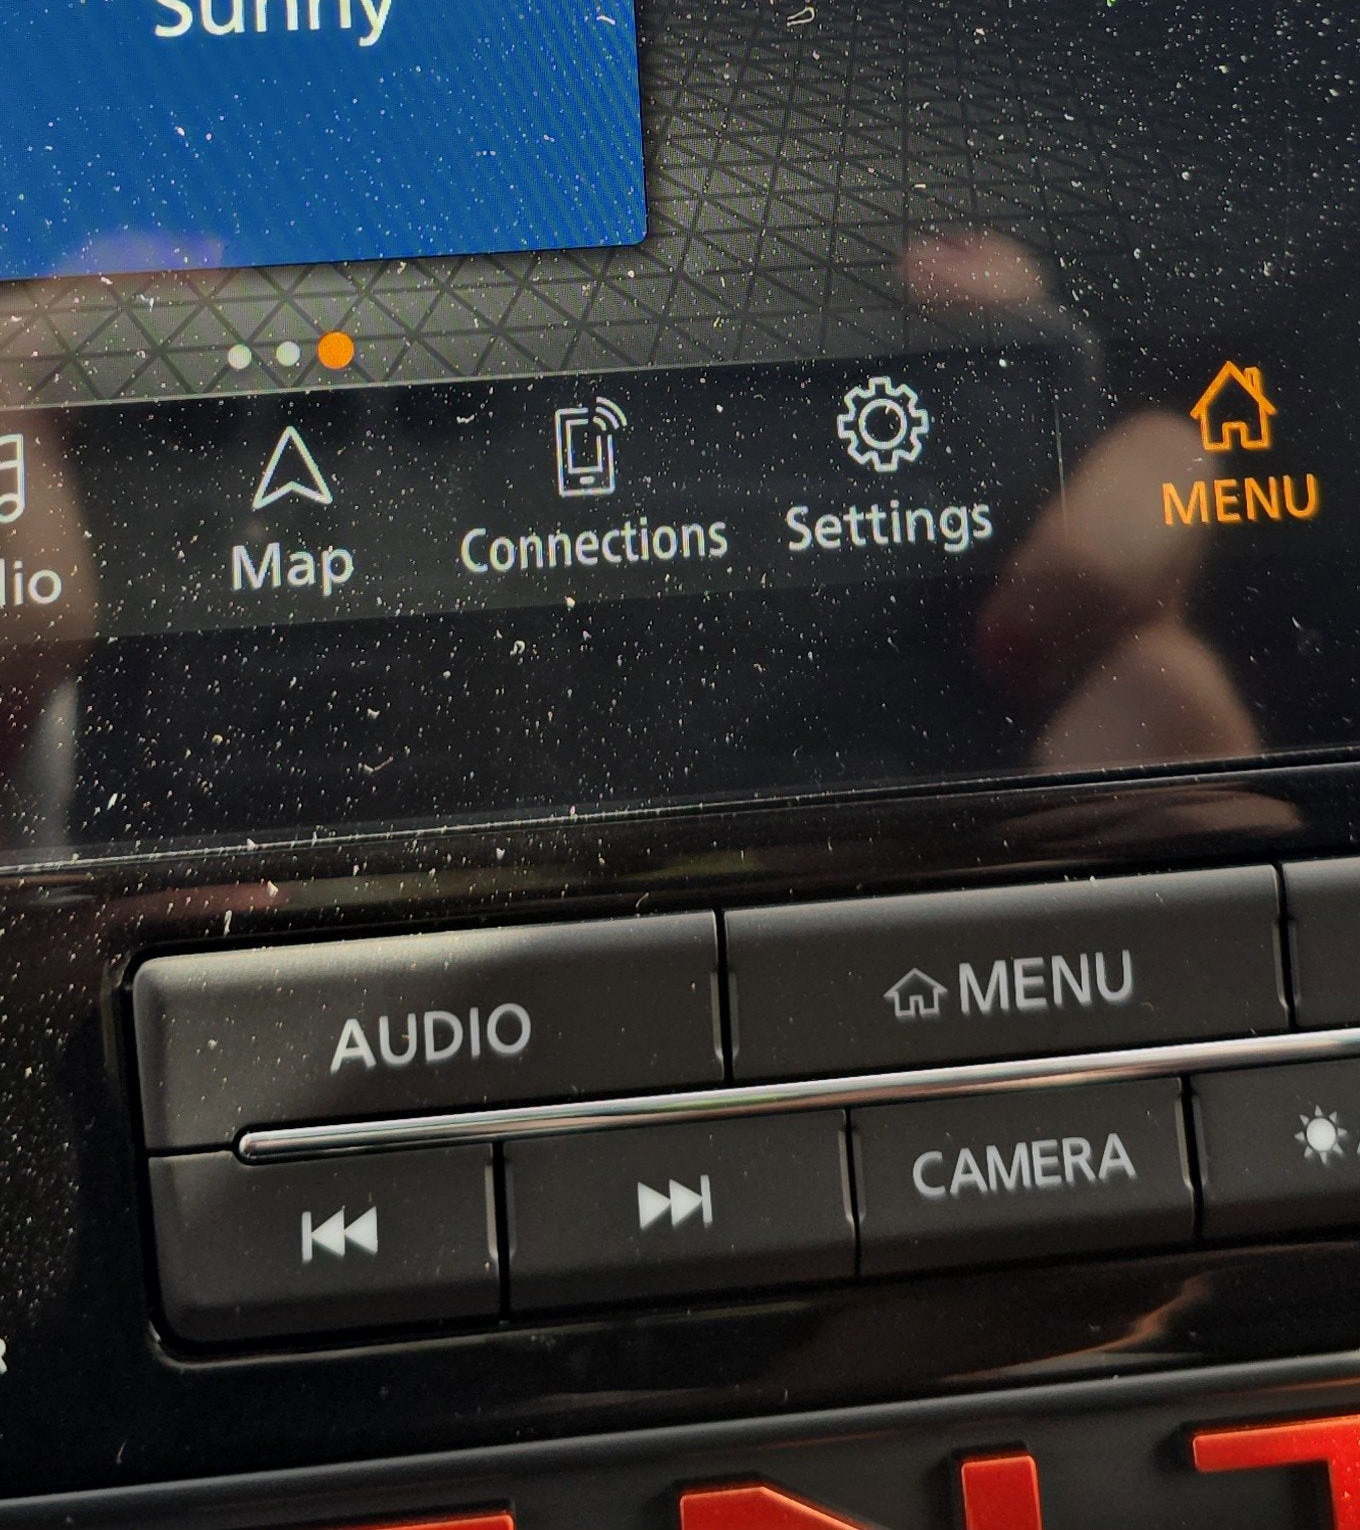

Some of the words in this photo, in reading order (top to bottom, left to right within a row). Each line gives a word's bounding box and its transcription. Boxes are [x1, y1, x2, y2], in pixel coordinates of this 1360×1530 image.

[1160, 474, 1316, 527] MENU
[461, 521, 727, 573] Connections
[785, 503, 992, 552] Settings
[232, 543, 354, 596] Map
[959, 951, 1132, 1013] MENU
[330, 1004, 530, 1073] AUDIO
[913, 1133, 1136, 1197] CAMERA
